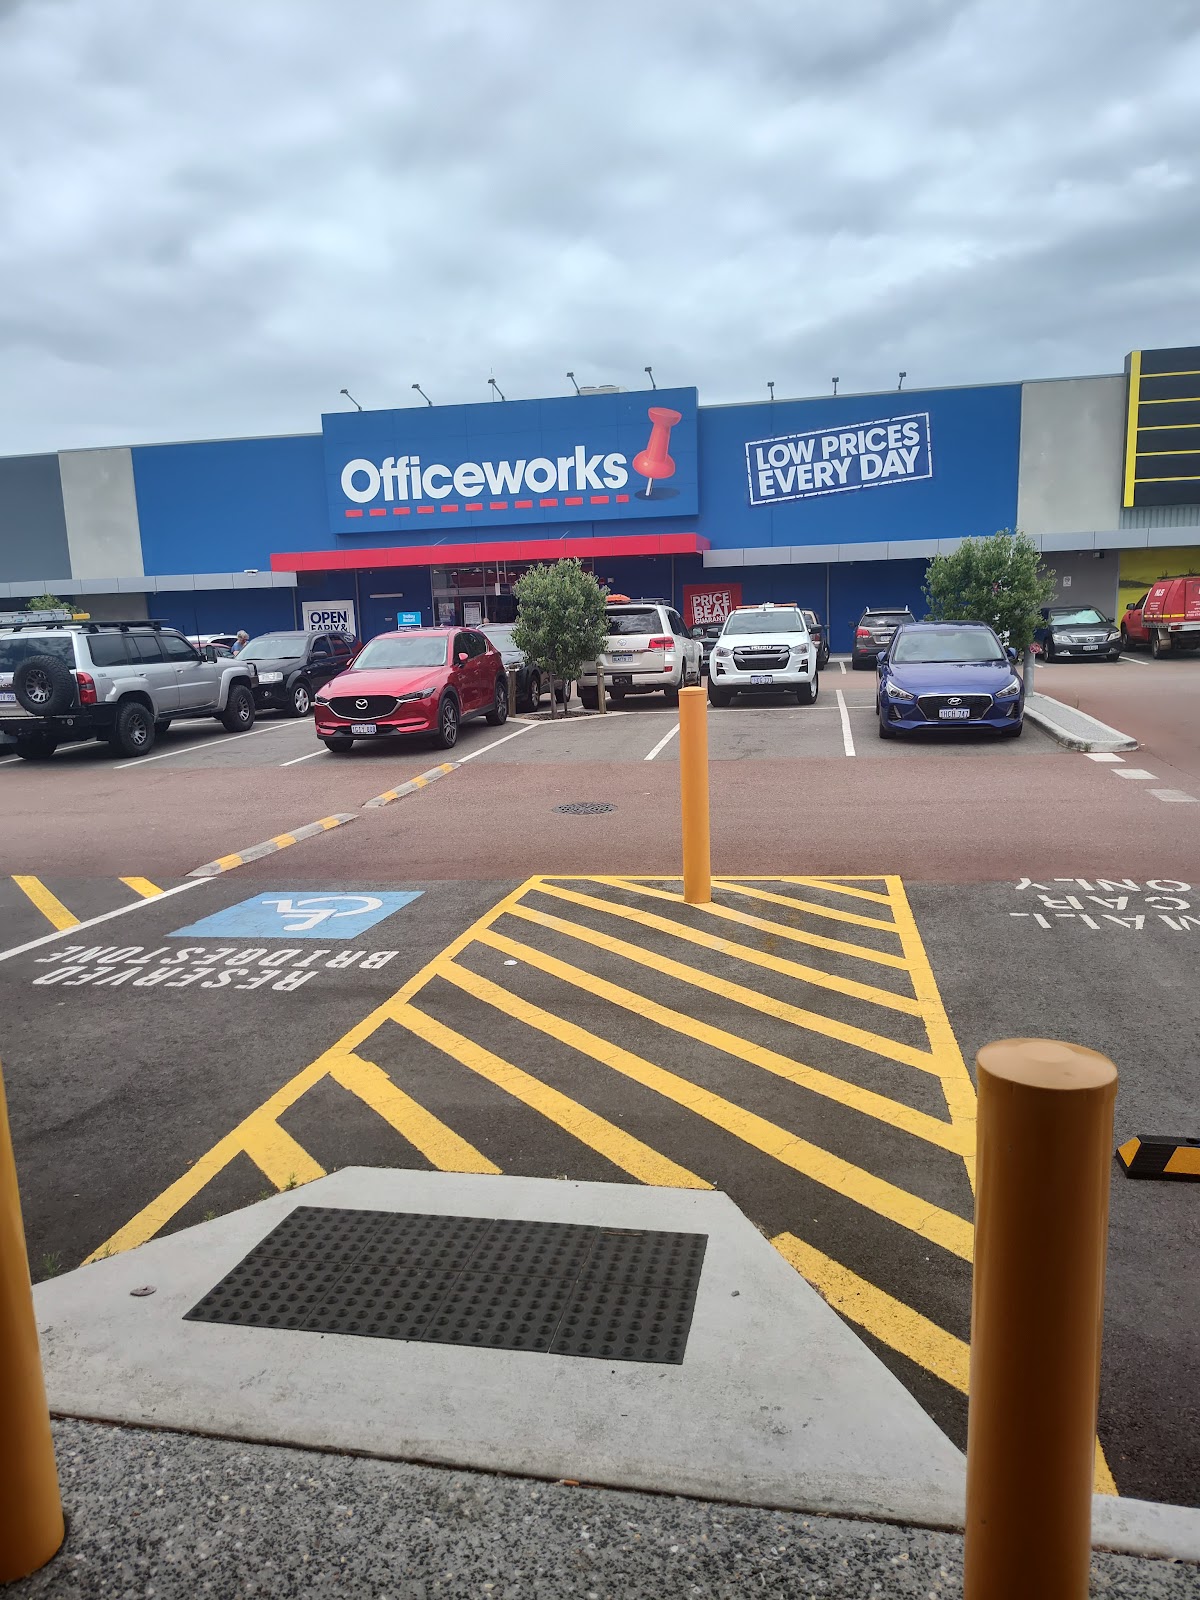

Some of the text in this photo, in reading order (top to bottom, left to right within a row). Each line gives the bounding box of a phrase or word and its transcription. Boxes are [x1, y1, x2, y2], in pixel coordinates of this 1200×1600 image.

[755, 421, 920, 471] LOW PRICES
[340, 445, 628, 504] Officeworks
[758, 445, 920, 497] EVERY DAY
[692, 592, 730, 607] PRICE
[310, 610, 348, 624] OPEN
[693, 602, 730, 619] BEAT
[695, 615, 729, 624] GUARANT
[1014, 877, 1192, 892] ONLY
[1036, 894, 1191, 910] CAR
[34, 944, 400, 970] BRIDGESTONE
[32, 966, 319, 992] RESERVED
